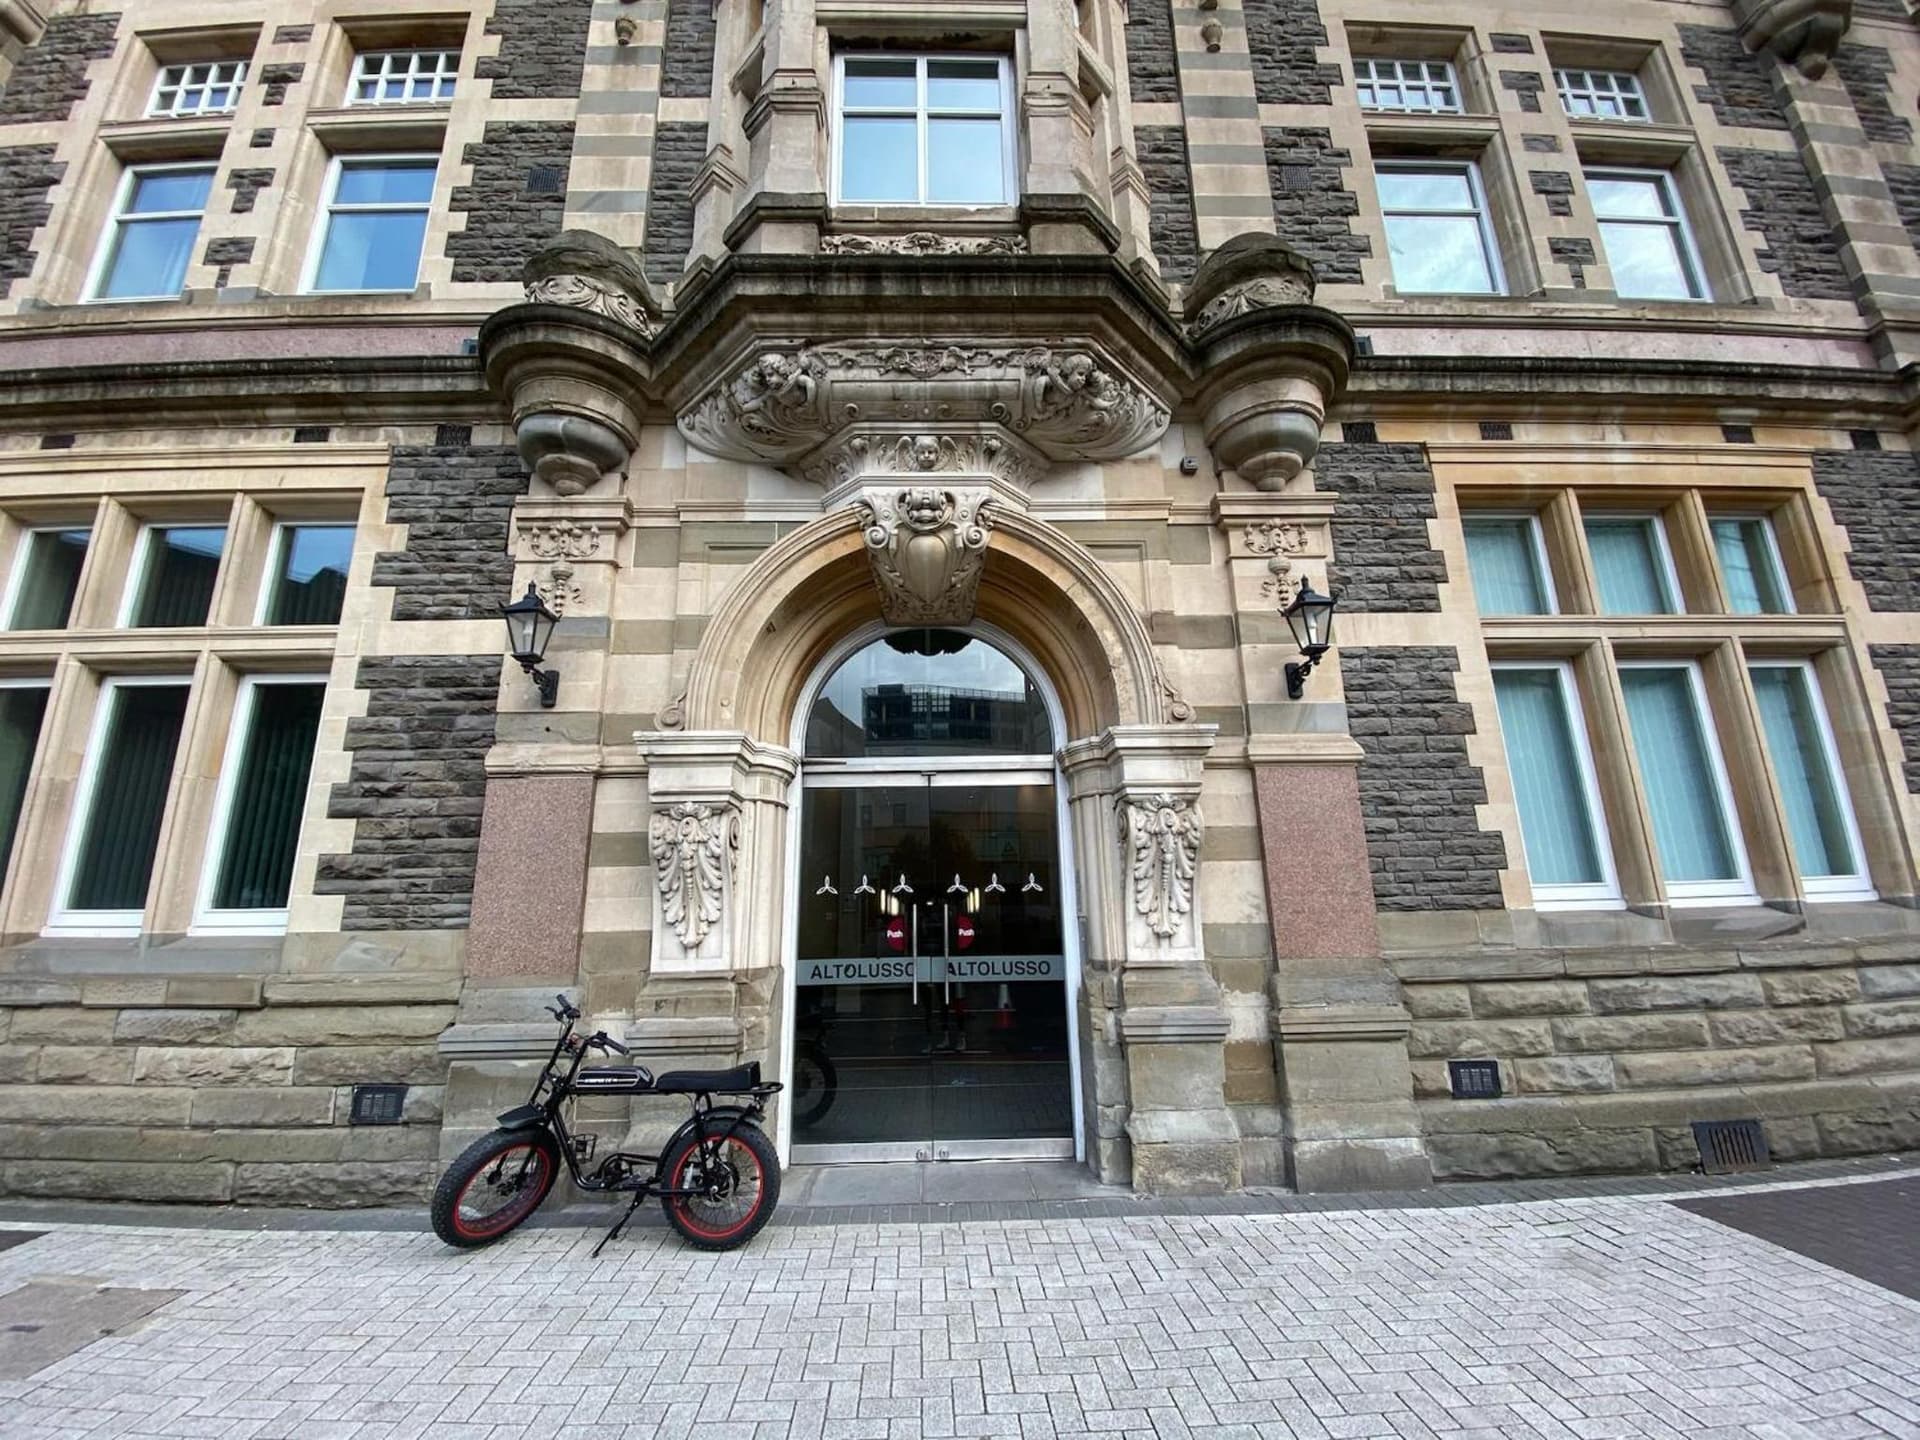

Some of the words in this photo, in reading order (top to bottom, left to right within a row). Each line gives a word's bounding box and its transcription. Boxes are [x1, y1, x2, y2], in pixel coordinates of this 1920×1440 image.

[887, 929, 904, 938] Push
[958, 928, 975, 937] Push
[810, 962, 915, 980] ALTOLUSSO
[946, 960, 1051, 976] ALTOLUSSO
